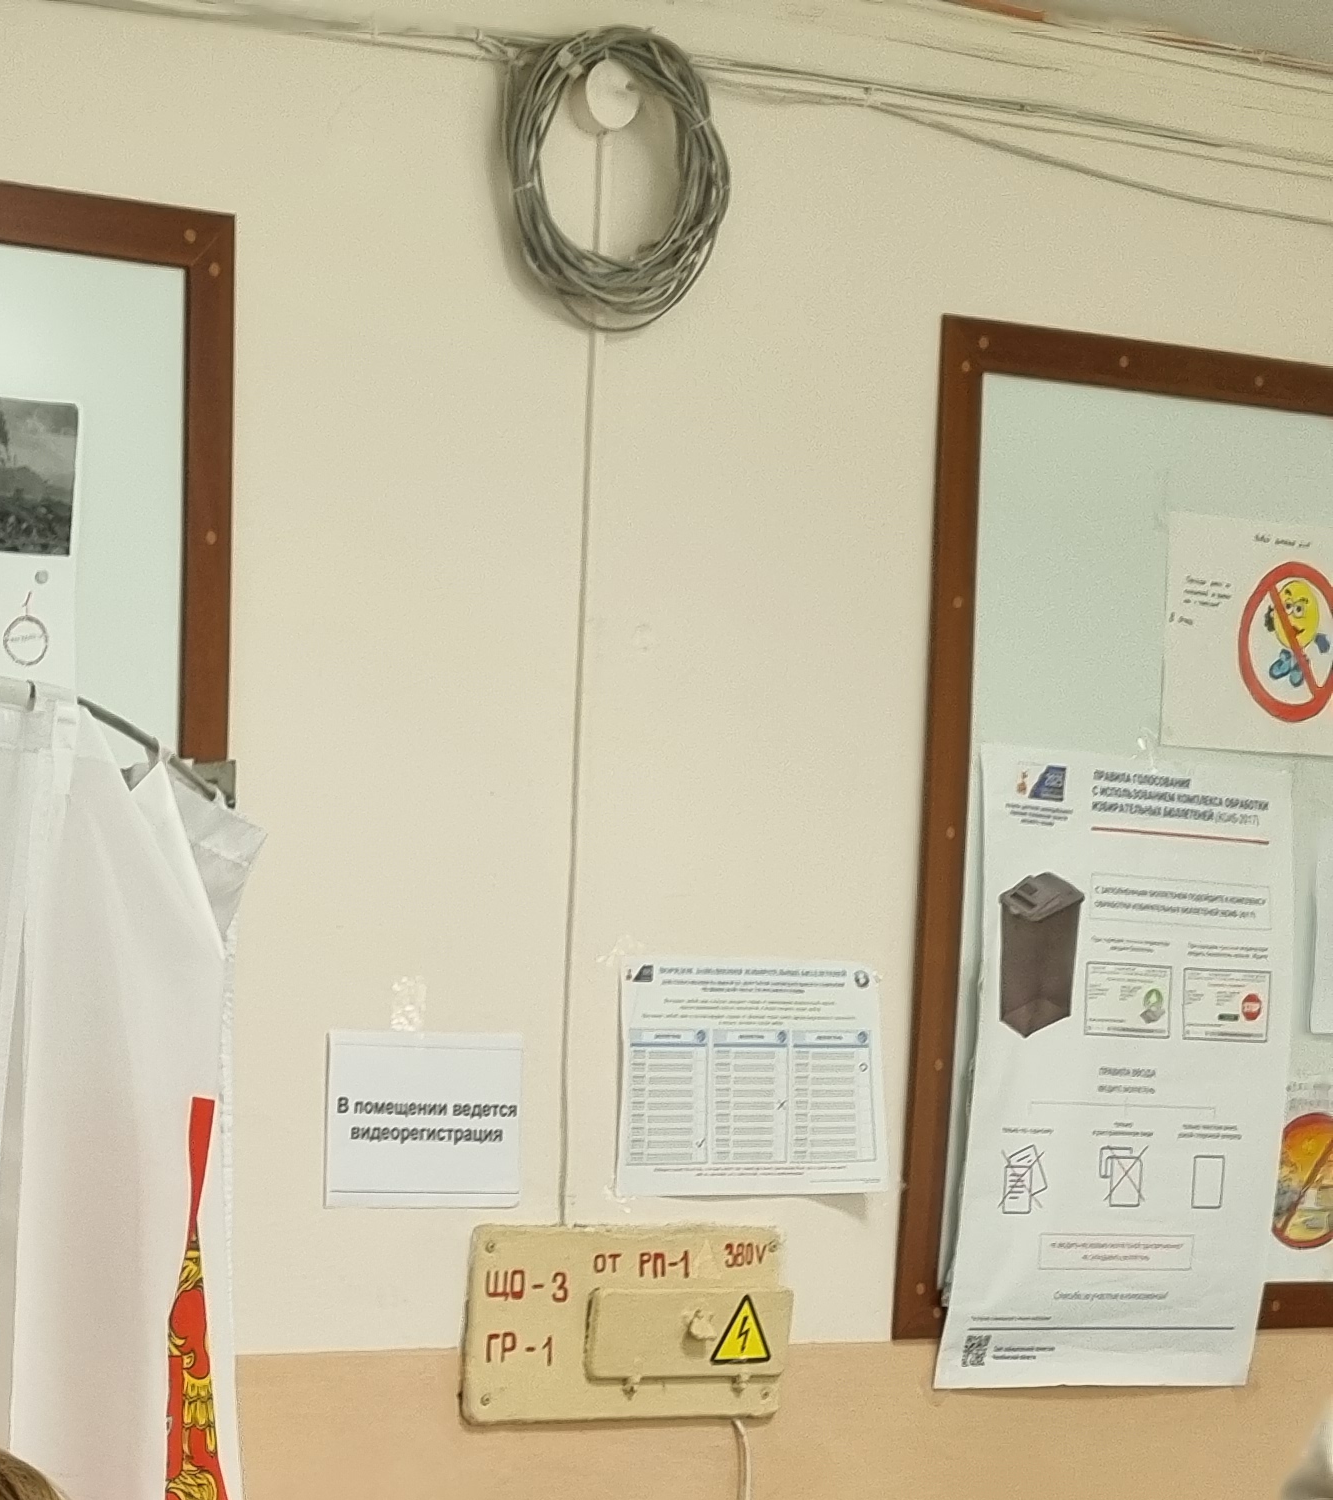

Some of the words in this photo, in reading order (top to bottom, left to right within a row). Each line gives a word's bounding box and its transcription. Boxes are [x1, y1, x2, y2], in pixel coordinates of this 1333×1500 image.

[336, 1096, 349, 1113] В
[353, 1100, 448, 1118] помещении
[452, 1102, 518, 1119] ведется
[350, 1126, 503, 1145] видеорегистрация
[593, 1253, 622, 1273] ОТ
[638, 1250, 691, 1279] РП-1
[724, 1242, 767, 1268] 380V
